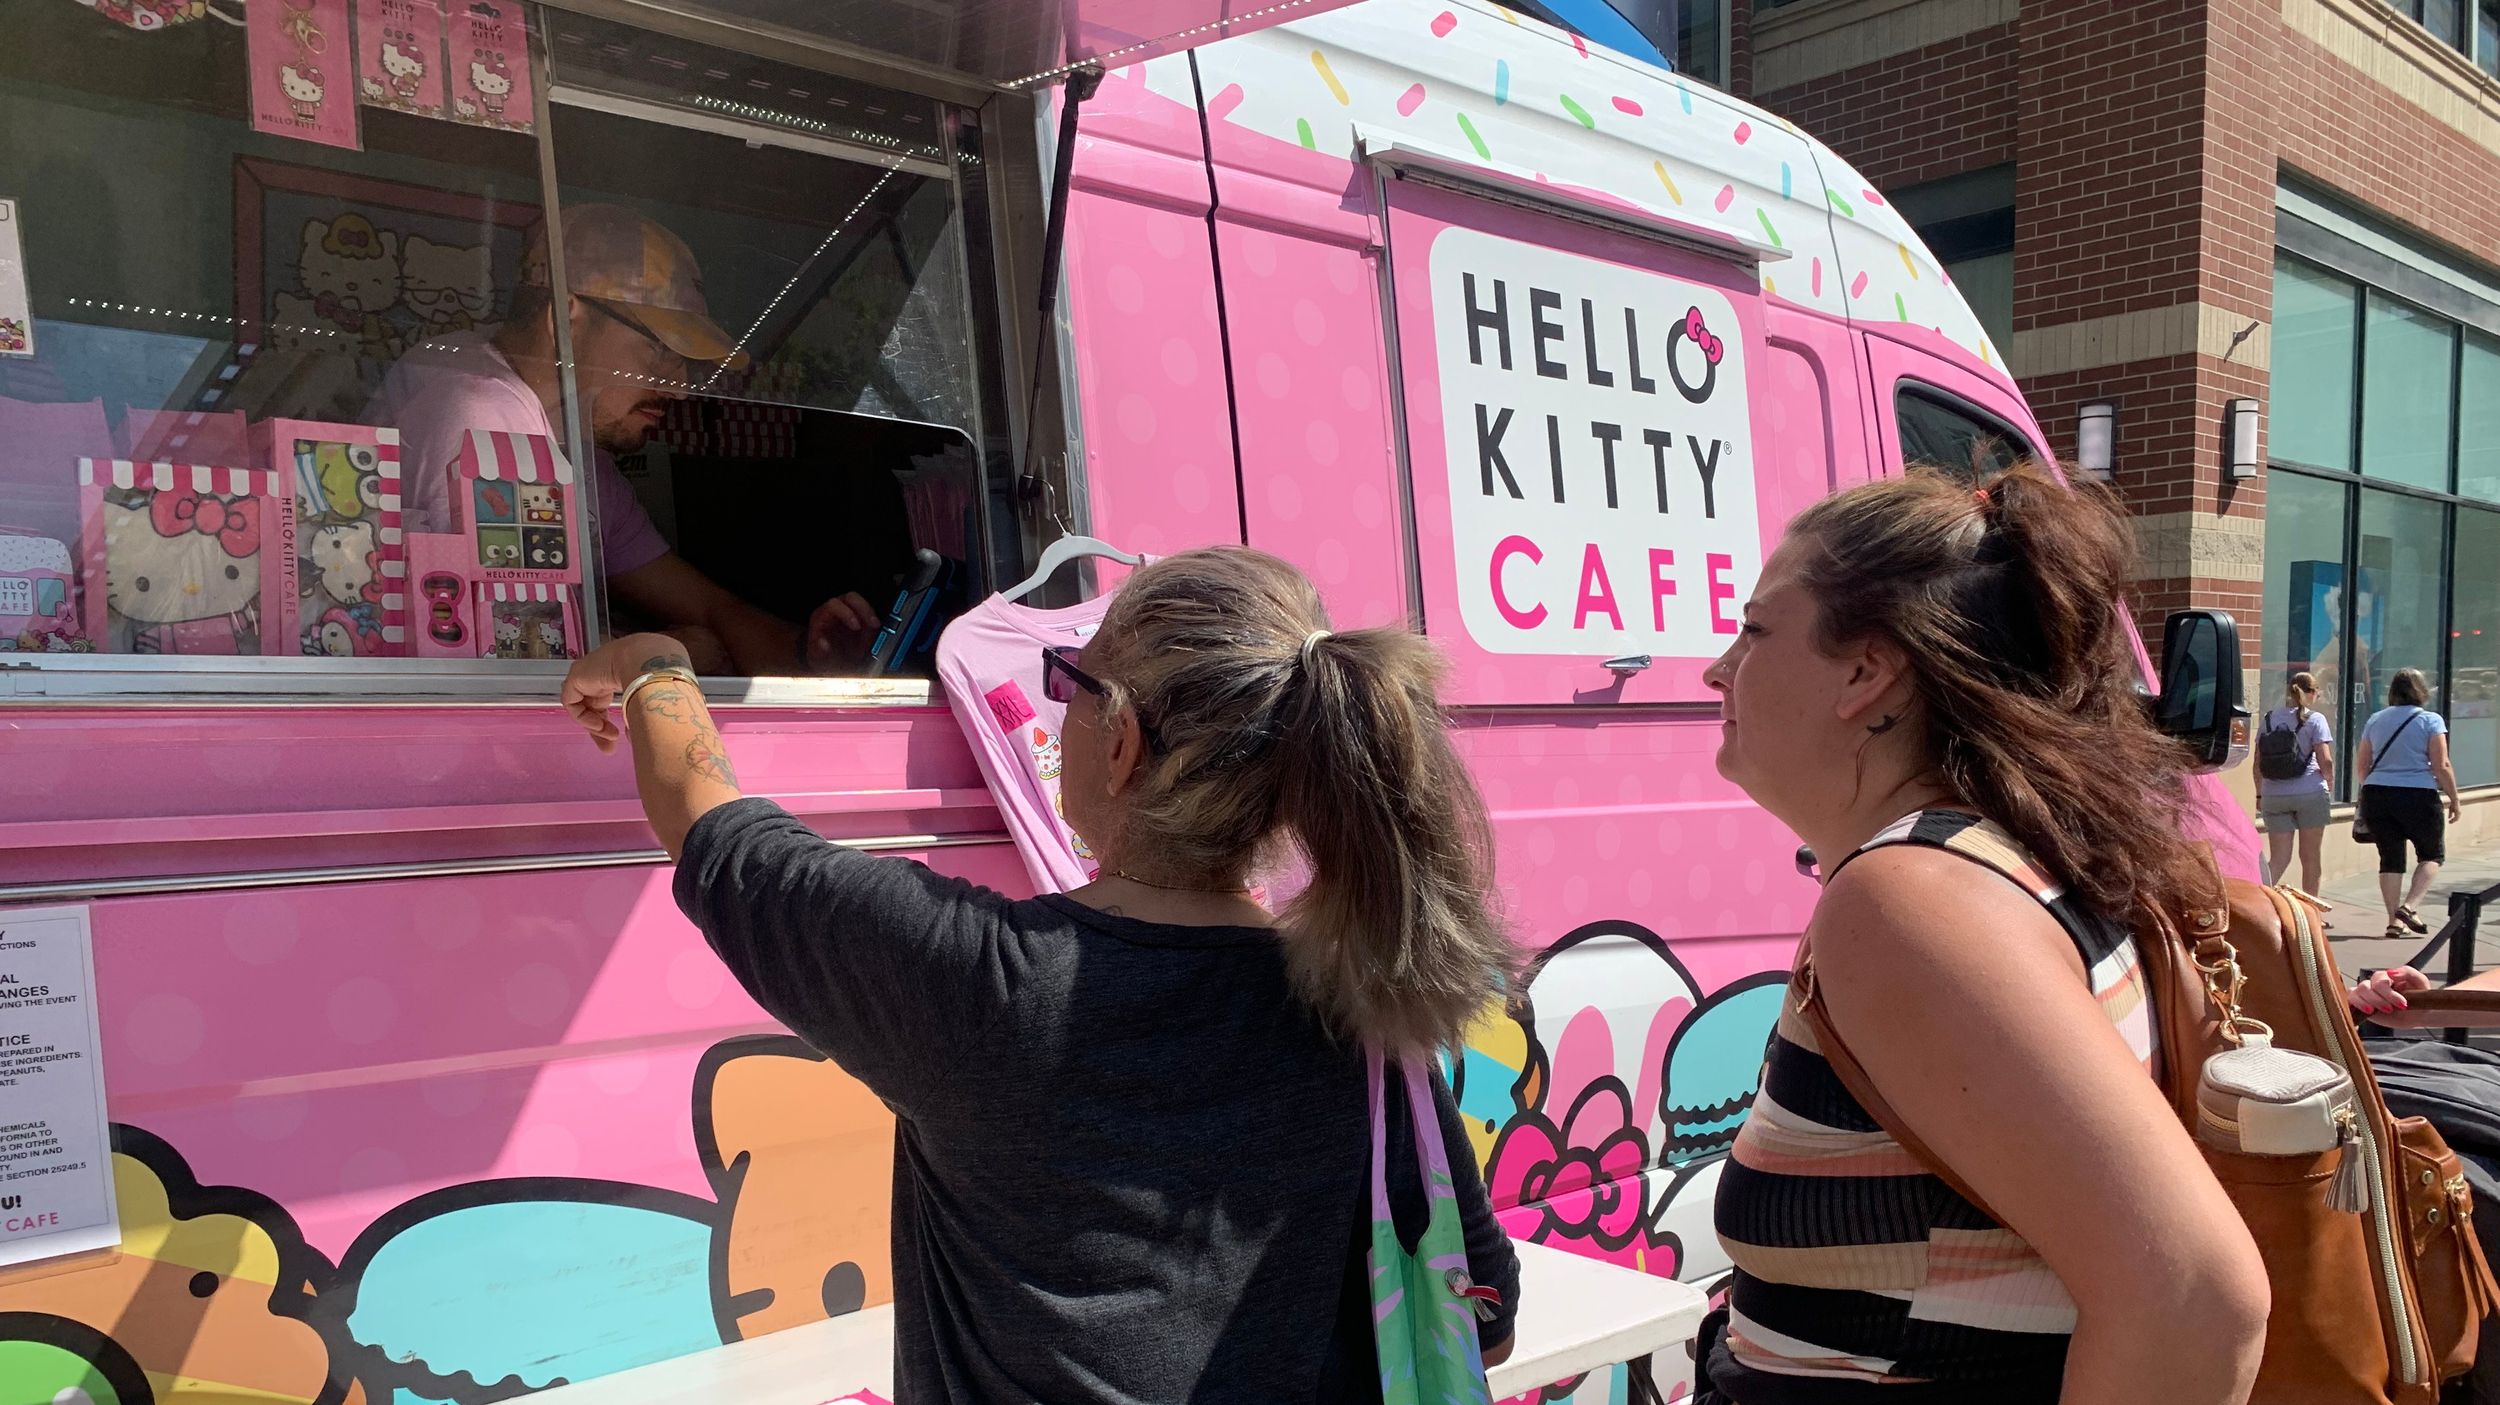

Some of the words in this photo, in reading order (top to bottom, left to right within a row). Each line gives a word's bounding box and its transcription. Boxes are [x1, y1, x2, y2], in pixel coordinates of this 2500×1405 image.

[381, 0, 415, 13] HELLO
[382, 8, 414, 22] KITTY
[471, 20, 503, 32] HELLO
[472, 30, 503, 42] KITTY
[261, 113, 293, 126] HELLO
[295, 119, 322, 131] KITTY
[1462, 271, 1723, 405] HELLO
[281, 497, 295, 541] HELLO
[283, 542, 295, 578] KITTY
[486, 570, 516, 579] HELLO
[516, 571, 540, 579] KITTY
[1490, 534, 1739, 635] CAFE
[284, 578, 296, 615] CAFE
[0, 974, 20, 984] AL
[23, 998, 44, 1007] THE
[45, 995, 78, 1005] EVENT
[44, 1045, 54, 1053] IN
[0, 1060, 14, 1068] SE
[39, 1129, 52, 1138] TO
[9, 1142, 23, 1151] OR
[25, 1137, 58, 1148] OTHER
[30, 1149, 40, 1158] IN
[42, 1146, 63, 1156] AND
[6, 1167, 49, 1181] SECTION
[50, 1161, 87, 1174] 25249.5
[1, 1195, 22, 1210] U!
[6, 1212, 59, 1232] CAFE
